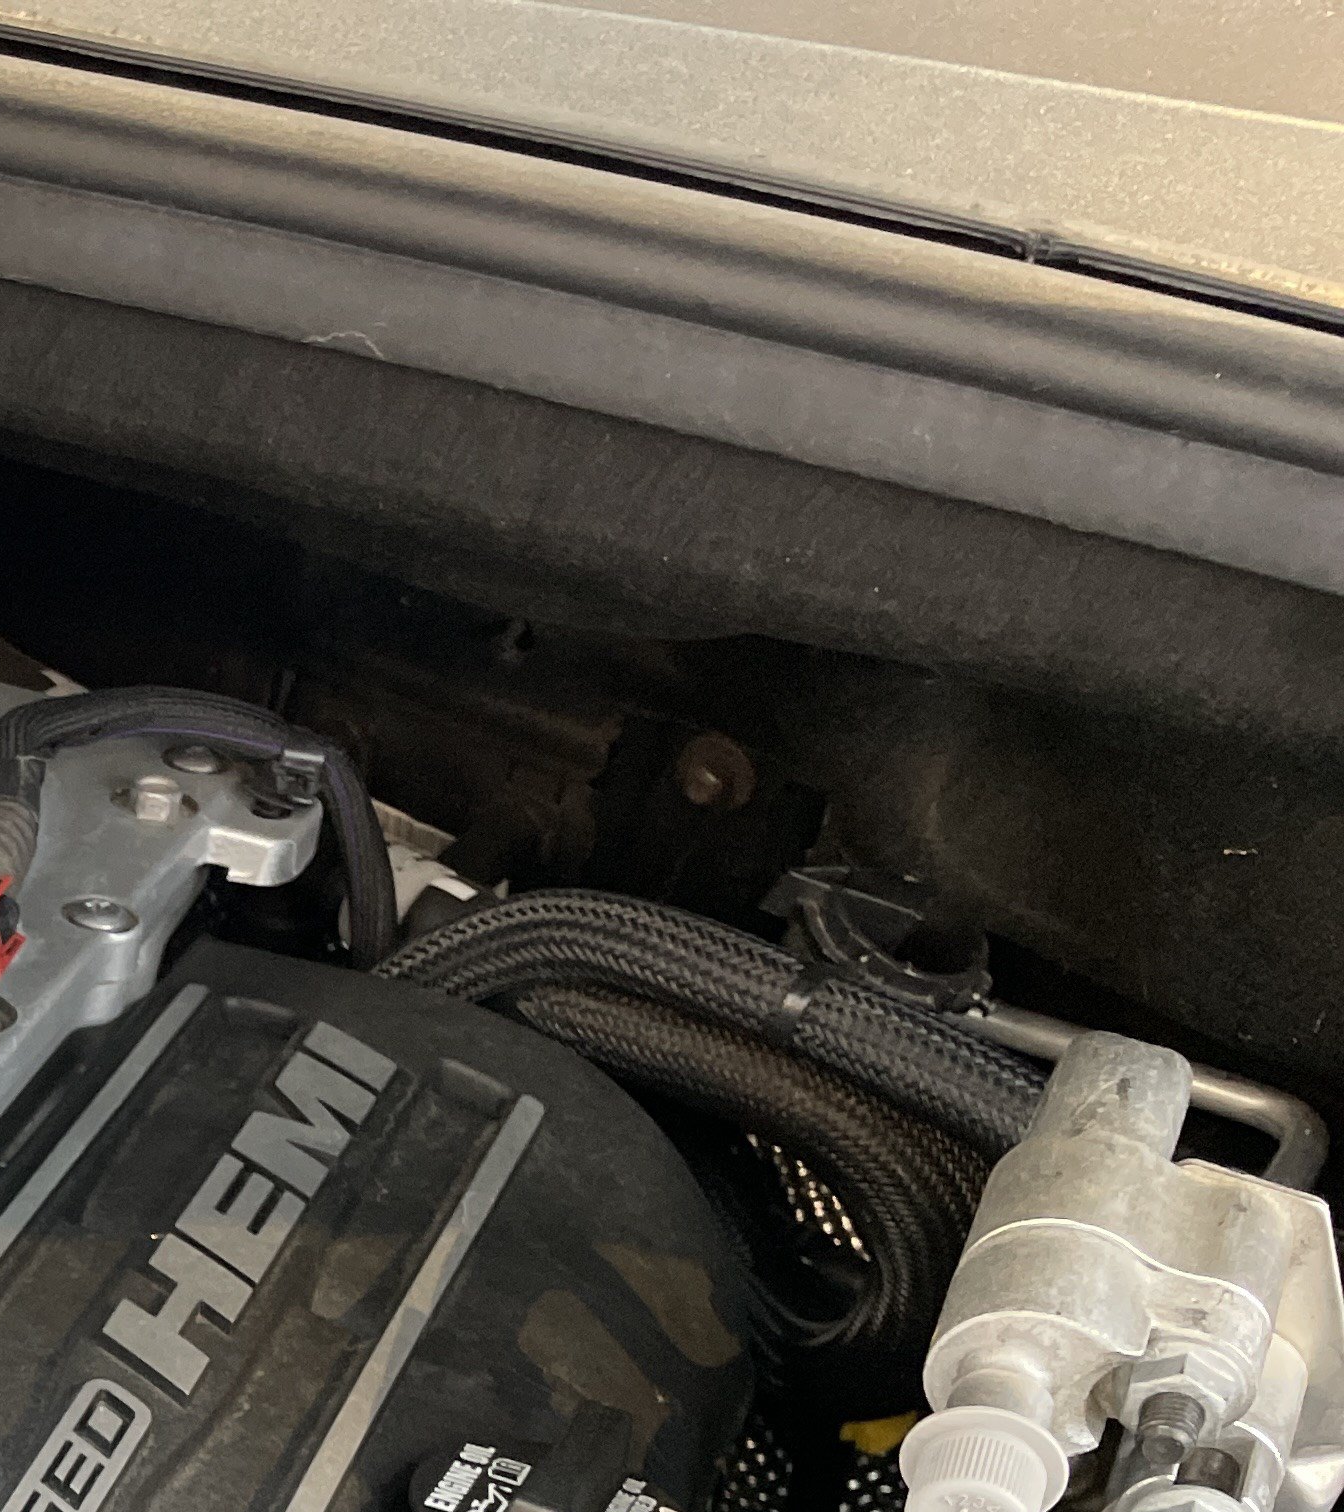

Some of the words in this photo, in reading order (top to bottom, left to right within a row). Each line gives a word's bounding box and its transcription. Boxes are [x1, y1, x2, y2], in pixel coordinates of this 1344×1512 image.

[102, 1020, 398, 1398] HEMI
[424, 1459, 483, 1512] ENGINE
[459, 1442, 496, 1465] OIL
